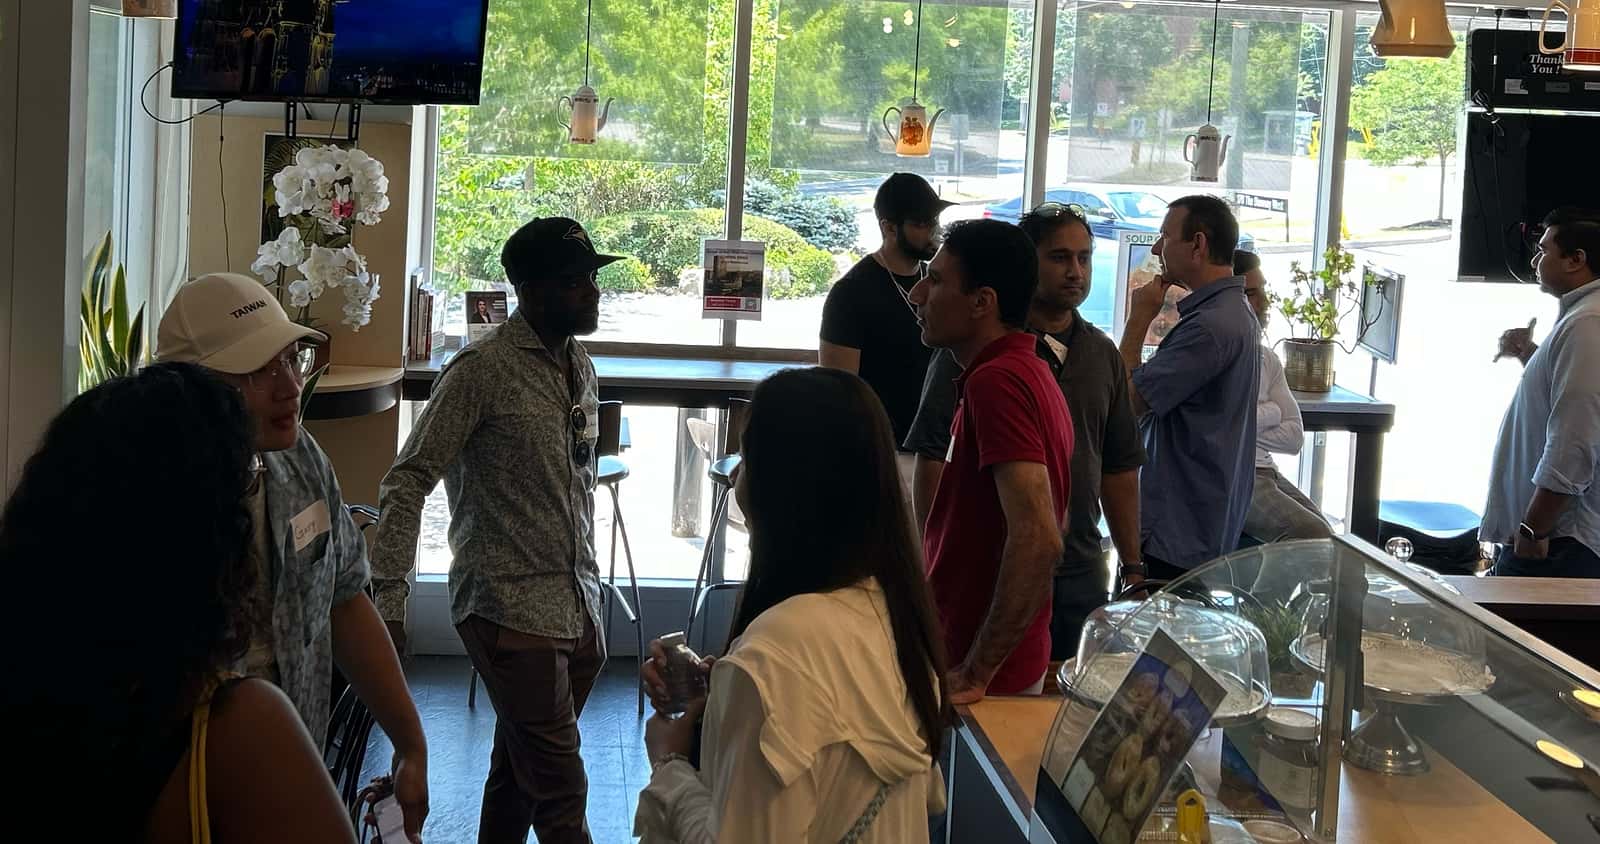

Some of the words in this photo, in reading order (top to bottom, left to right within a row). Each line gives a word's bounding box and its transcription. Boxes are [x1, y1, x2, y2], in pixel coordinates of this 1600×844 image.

[1529, 54, 1562, 65] Thank
[1532, 64, 1553, 74] You
[1125, 234, 1153, 243] SOUP
[230, 299, 267, 319] TAIWAN
